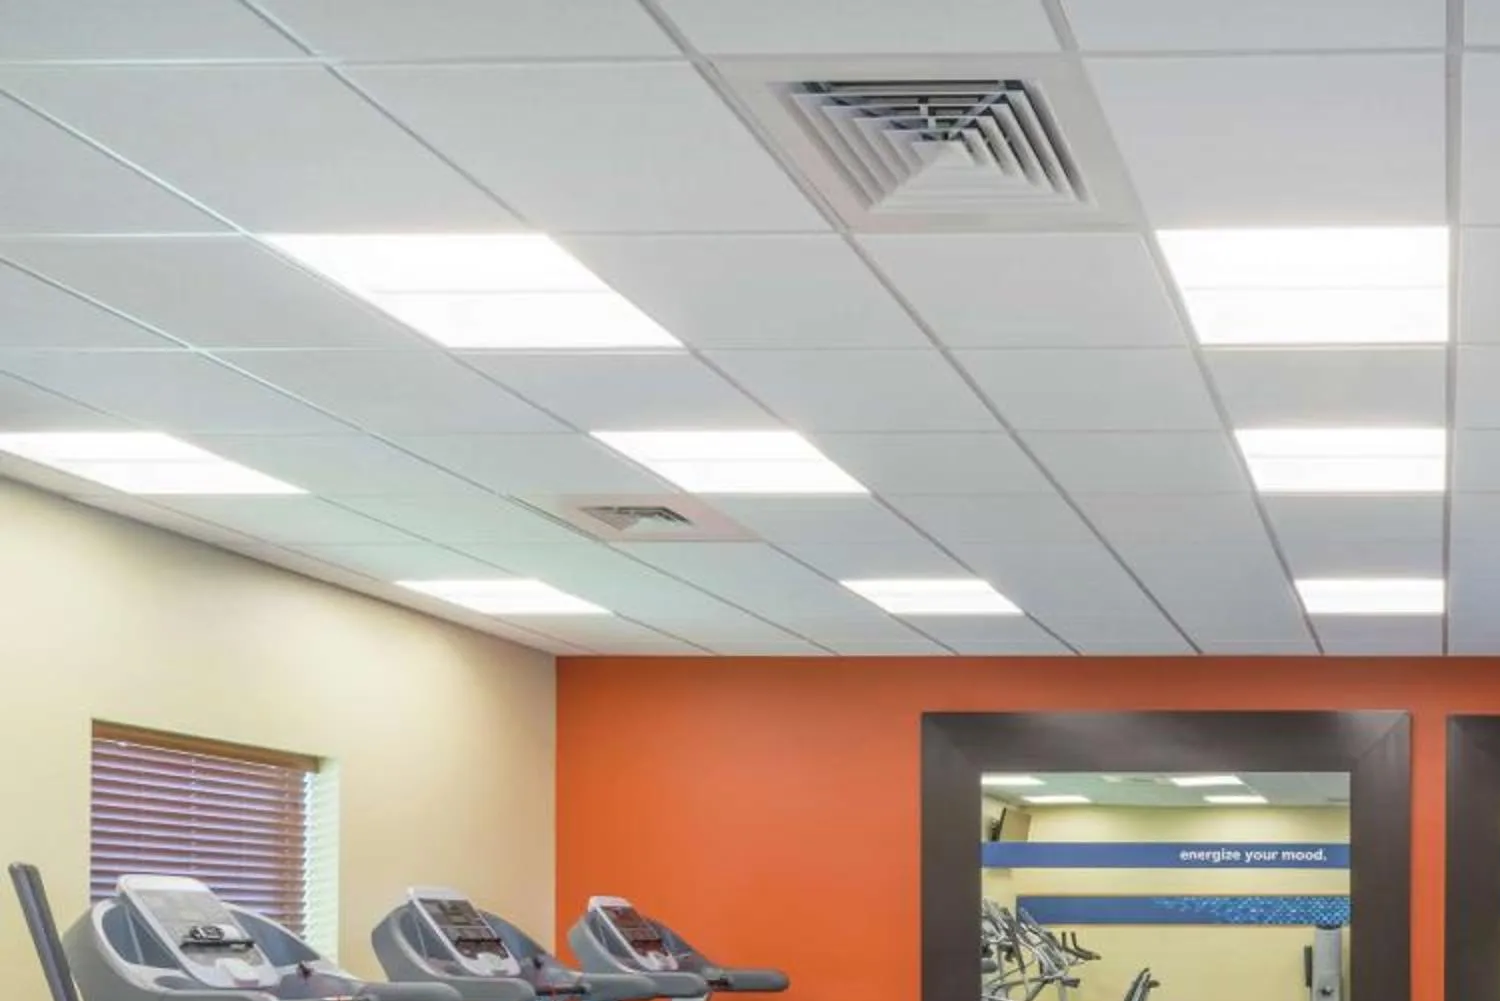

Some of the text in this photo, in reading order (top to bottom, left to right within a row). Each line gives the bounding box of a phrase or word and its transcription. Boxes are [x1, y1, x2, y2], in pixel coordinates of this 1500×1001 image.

[1179, 848, 1328, 864] energize your mood.
